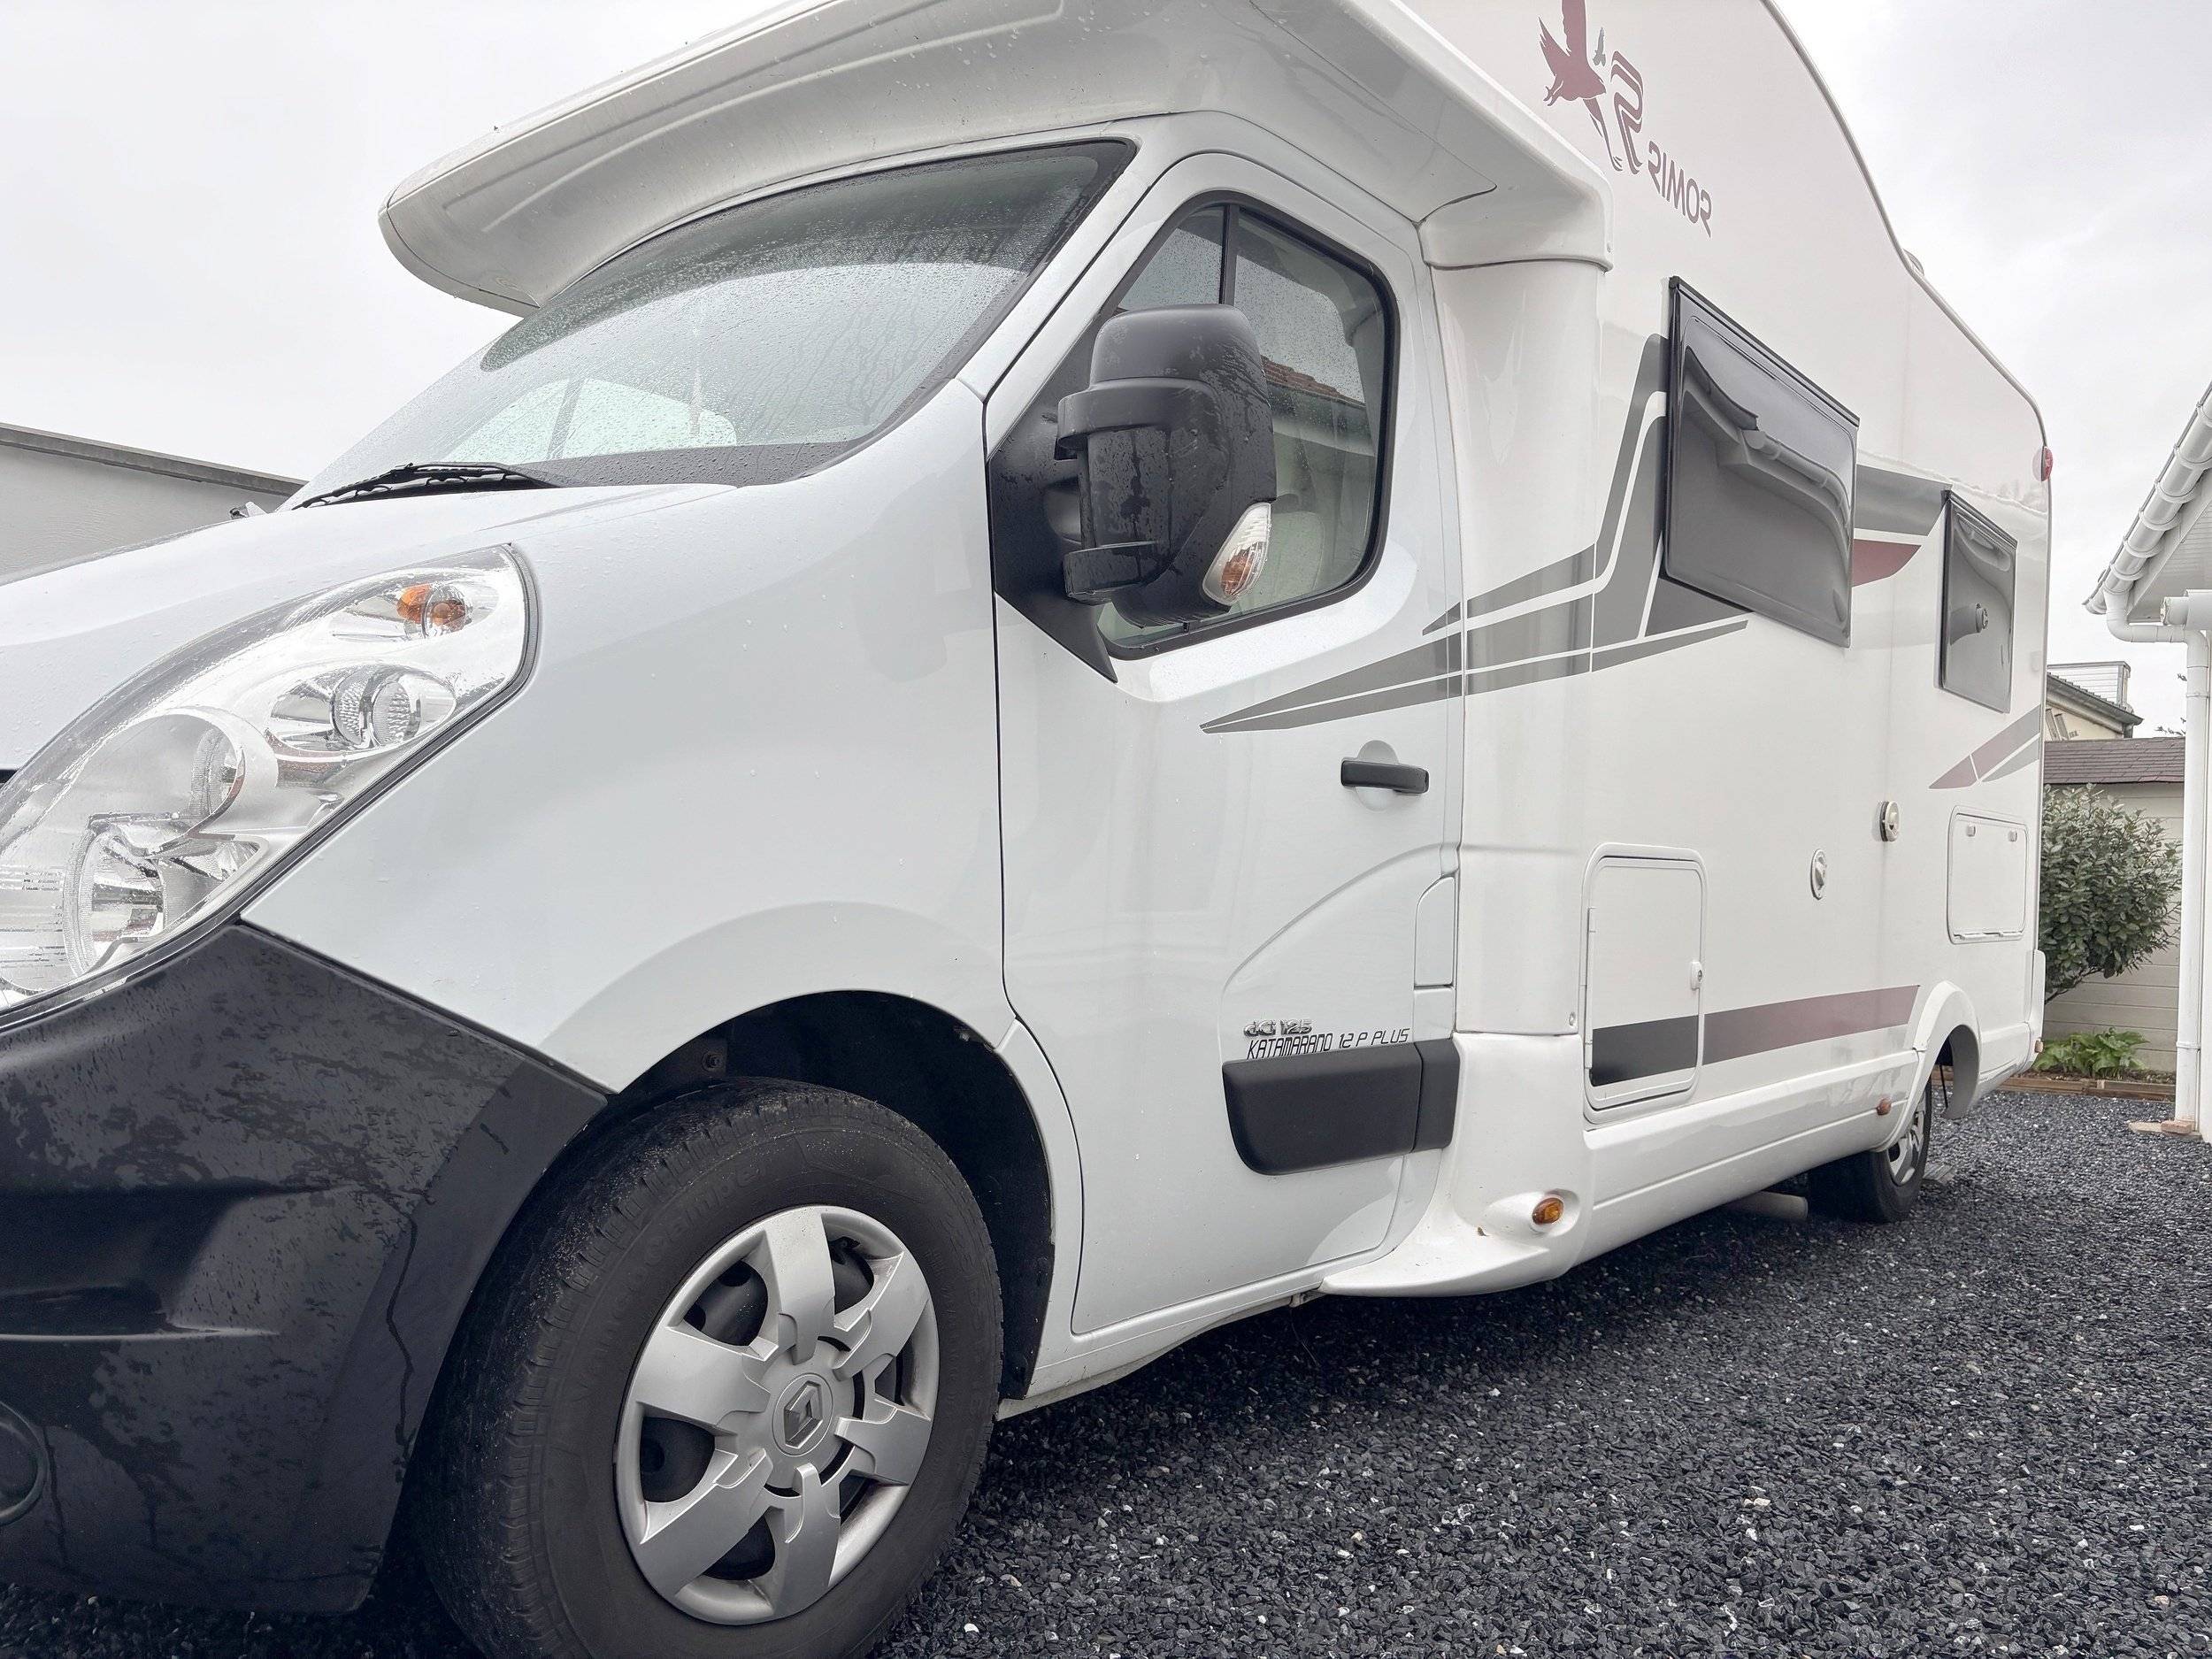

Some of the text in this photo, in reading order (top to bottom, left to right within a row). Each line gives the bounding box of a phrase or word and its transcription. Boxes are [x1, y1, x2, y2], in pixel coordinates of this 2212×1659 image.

[1647, 140, 1712, 238] RIMOR
[1279, 1018, 1313, 1035] 125
[1247, 1028, 1410, 1059] KATAMARANO 12 P PLUS
